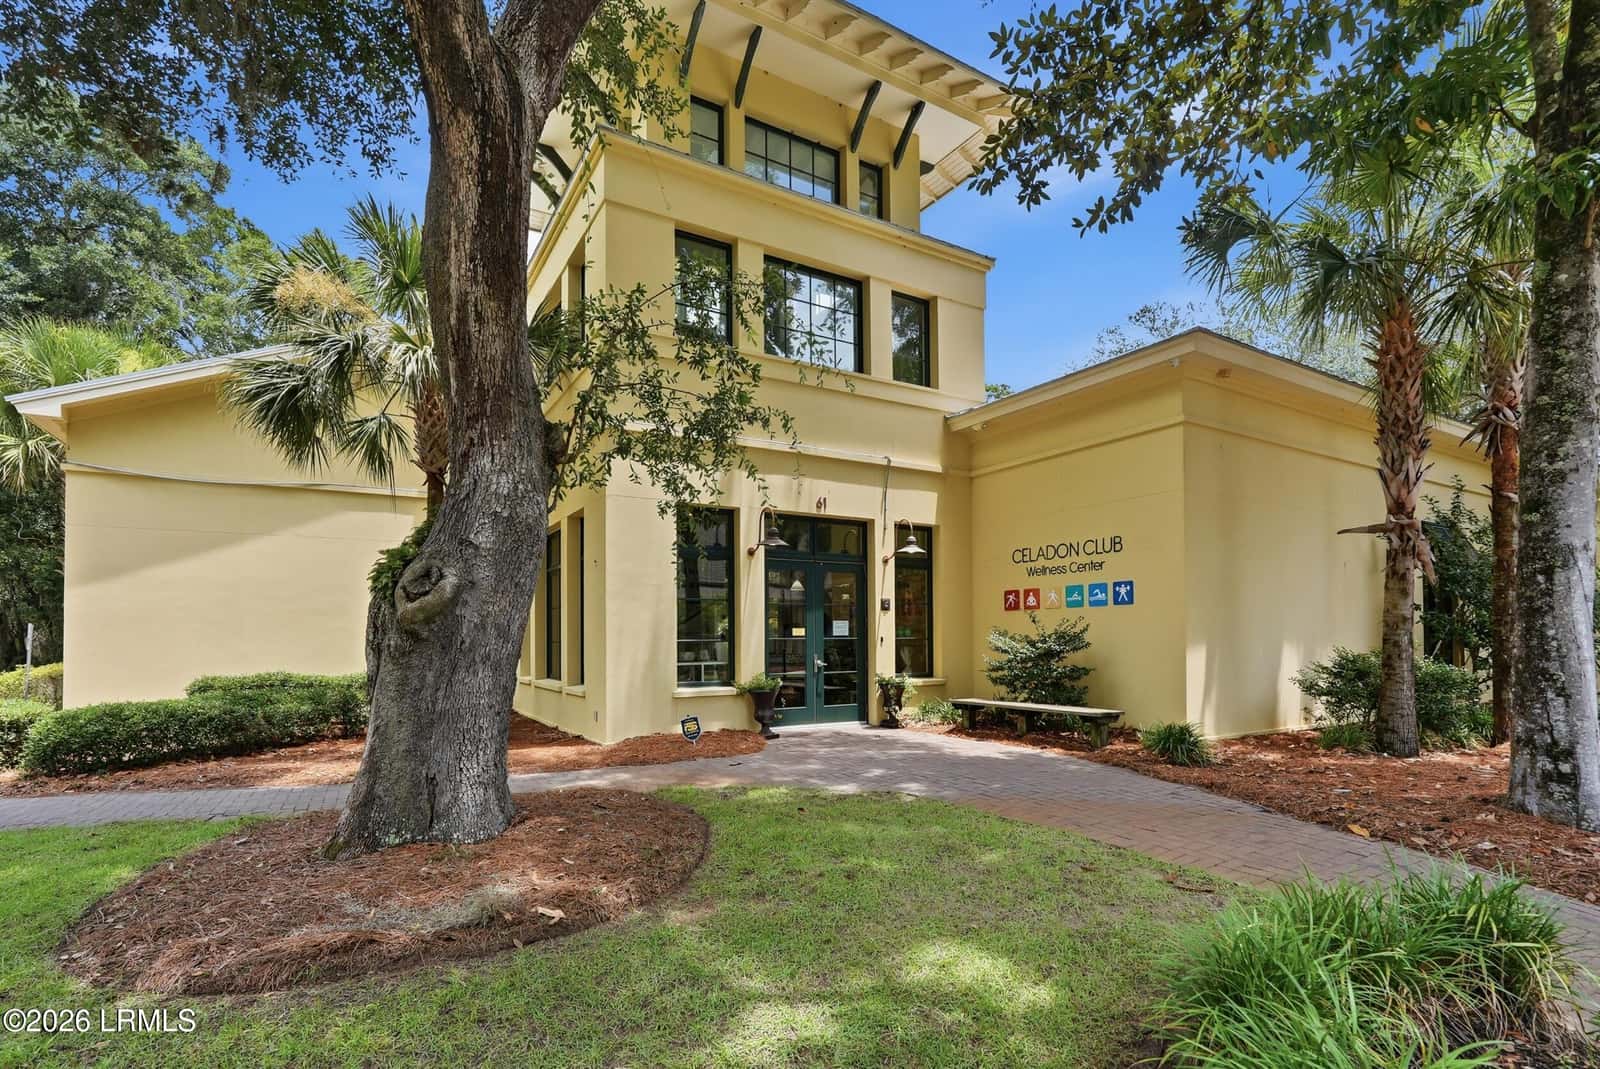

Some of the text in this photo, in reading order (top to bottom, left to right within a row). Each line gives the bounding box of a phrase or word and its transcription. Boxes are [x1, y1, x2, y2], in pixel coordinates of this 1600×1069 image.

[815, 495, 827, 512] 61
[1012, 535, 1124, 564] CELADON CLUB
[1026, 560, 1106, 577] Wellness Center
